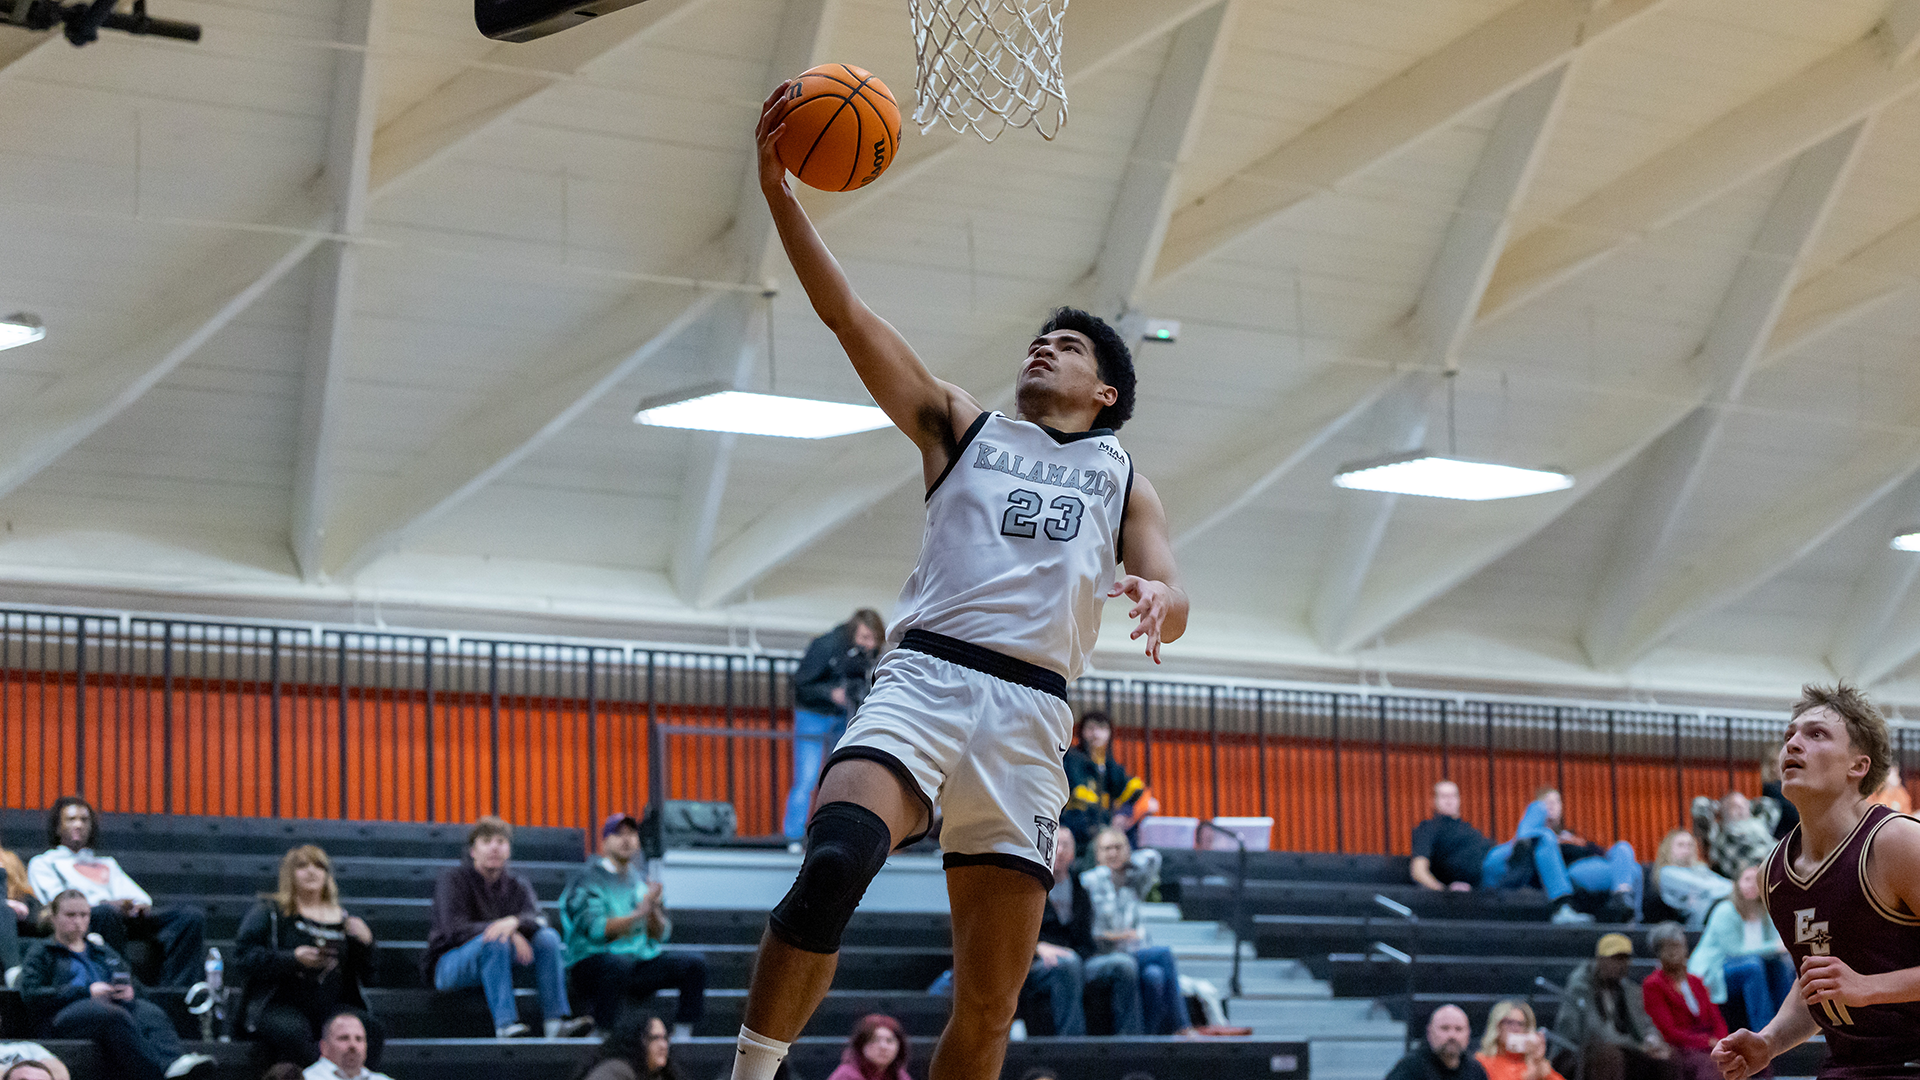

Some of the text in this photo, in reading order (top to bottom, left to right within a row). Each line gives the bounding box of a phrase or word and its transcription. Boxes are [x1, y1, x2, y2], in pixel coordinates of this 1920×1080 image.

[860, 138, 885, 188] lson
[1099, 441, 1126, 464] MIAA
[1000, 488, 1085, 542] 23
